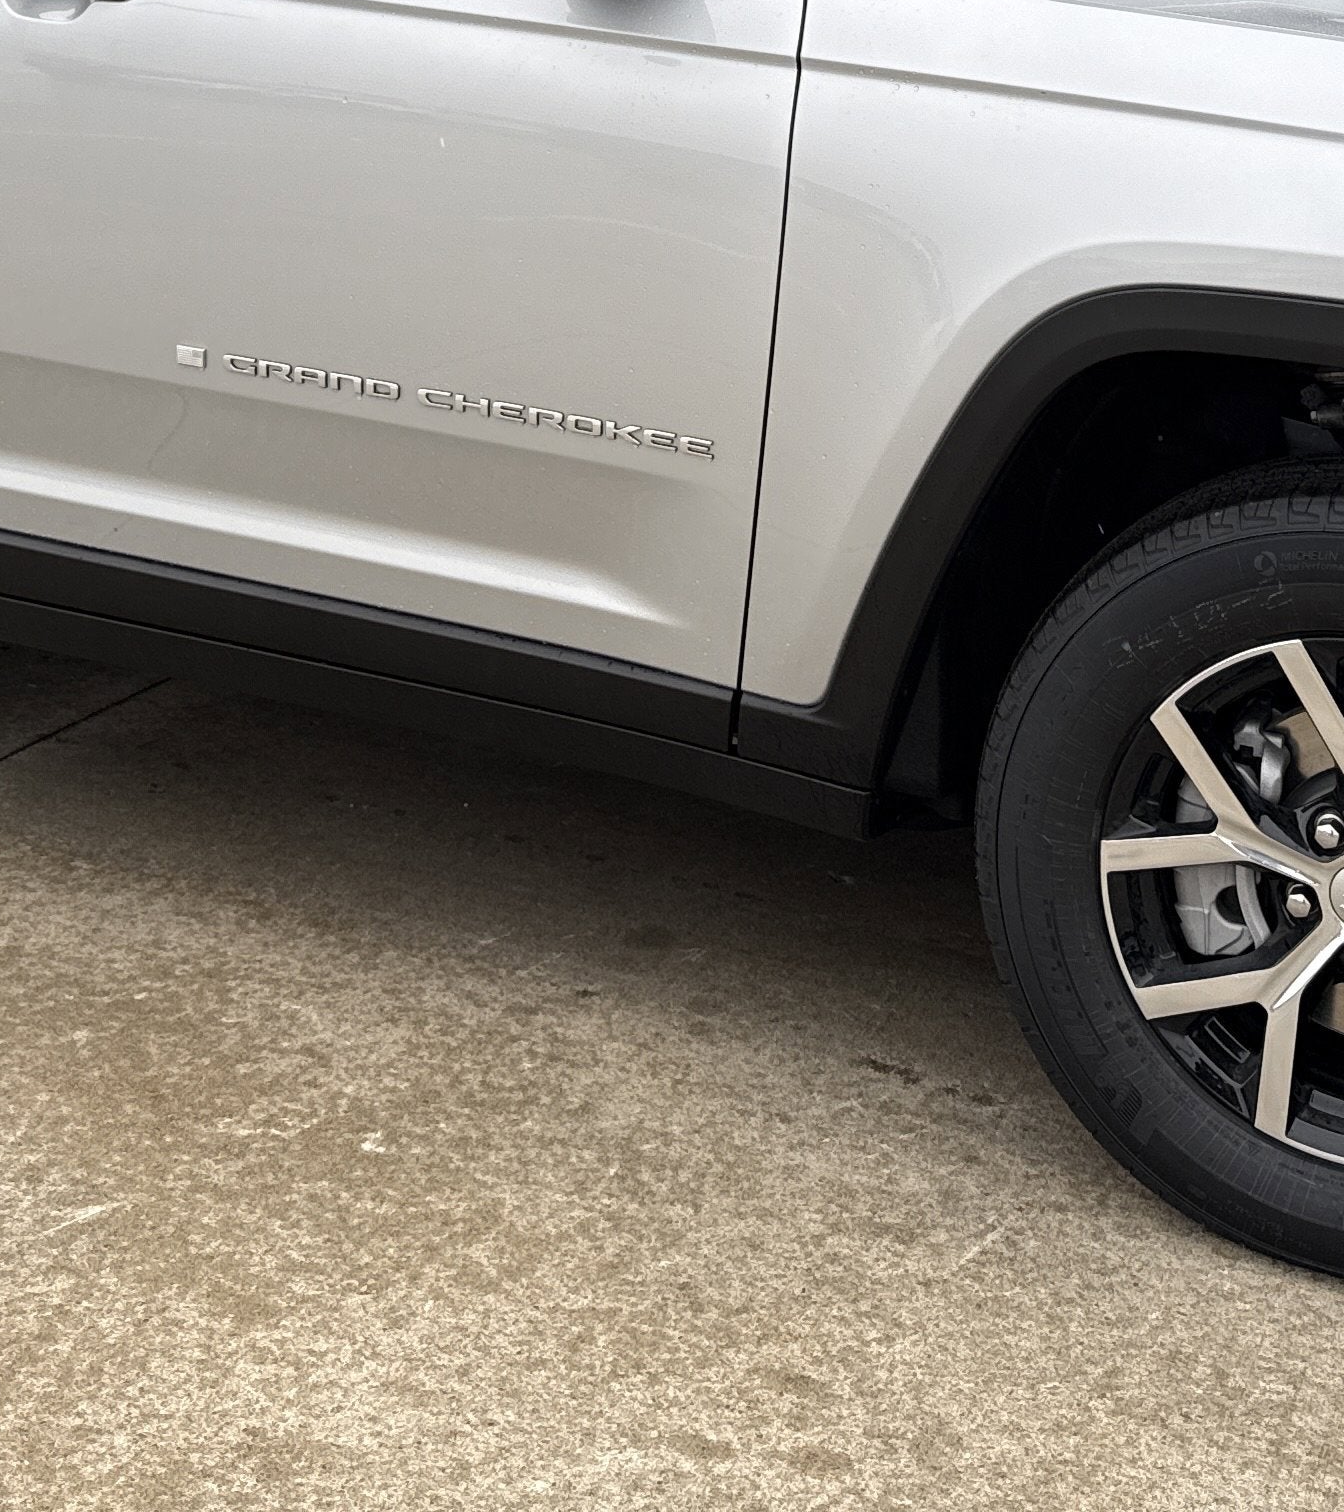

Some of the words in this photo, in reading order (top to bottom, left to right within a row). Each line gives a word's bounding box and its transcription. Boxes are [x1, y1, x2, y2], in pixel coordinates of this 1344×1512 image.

[222, 352, 400, 401] GRAND
[416, 387, 715, 462] CHEROKEE
[1280, 549, 1339, 562] MICHELIN
